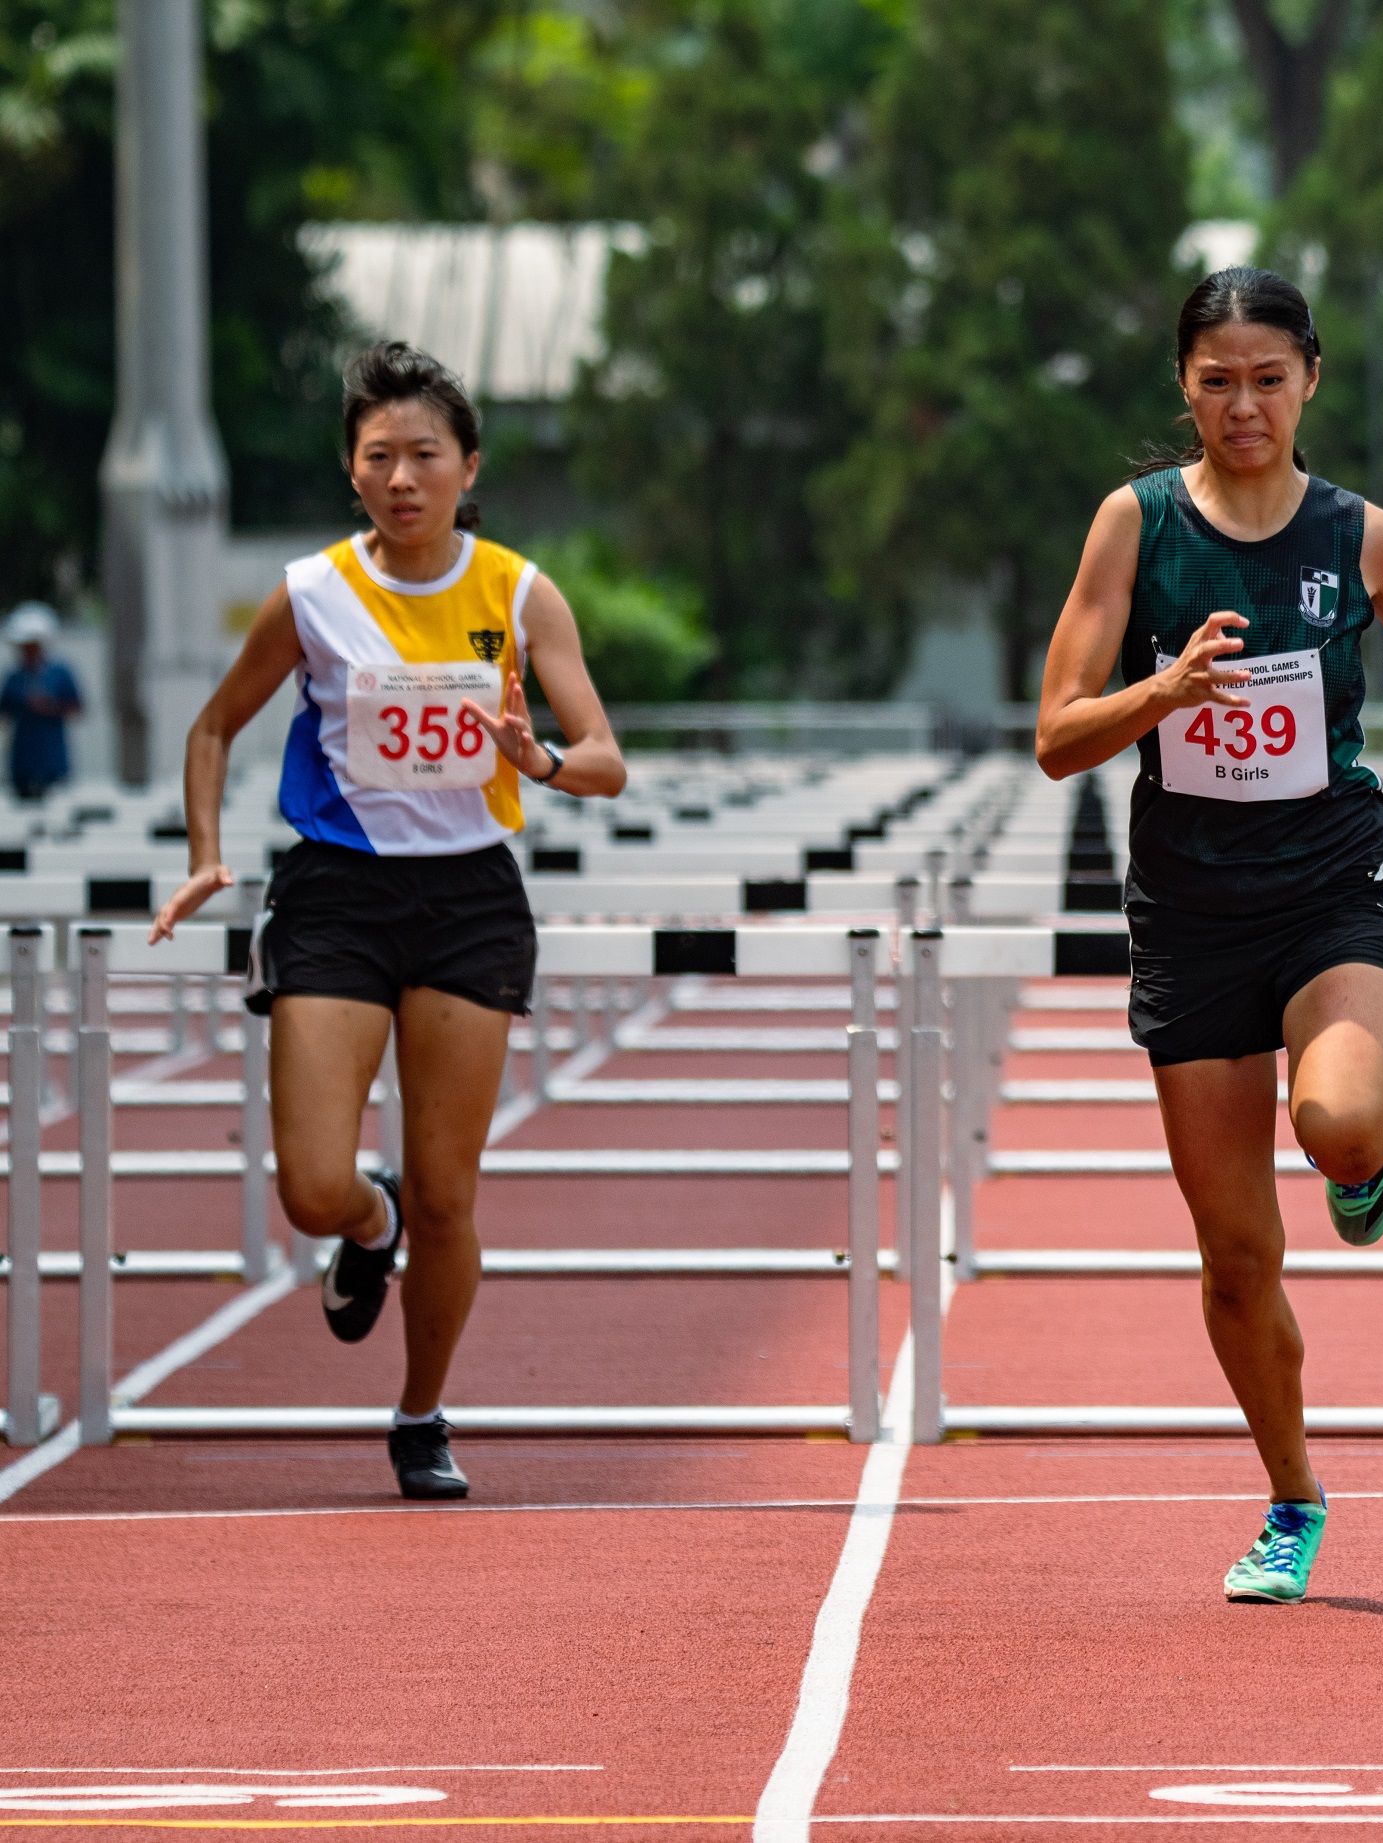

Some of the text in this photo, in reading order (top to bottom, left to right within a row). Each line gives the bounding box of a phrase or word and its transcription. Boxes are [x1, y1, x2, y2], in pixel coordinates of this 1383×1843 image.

[1271, 660, 1300, 672] GAMES
[426, 674, 454, 682] SCHOOL
[1222, 671, 1314, 689] FIELD CHAMPIONSHIPS
[434, 682, 491, 690] CHAMPIONSHIPS
[377, 705, 484, 762] 358
[1184, 704, 1297, 760] 439
[412, 764, 443, 774] B GIRLS
[1215, 765, 1269, 781] B Girls
